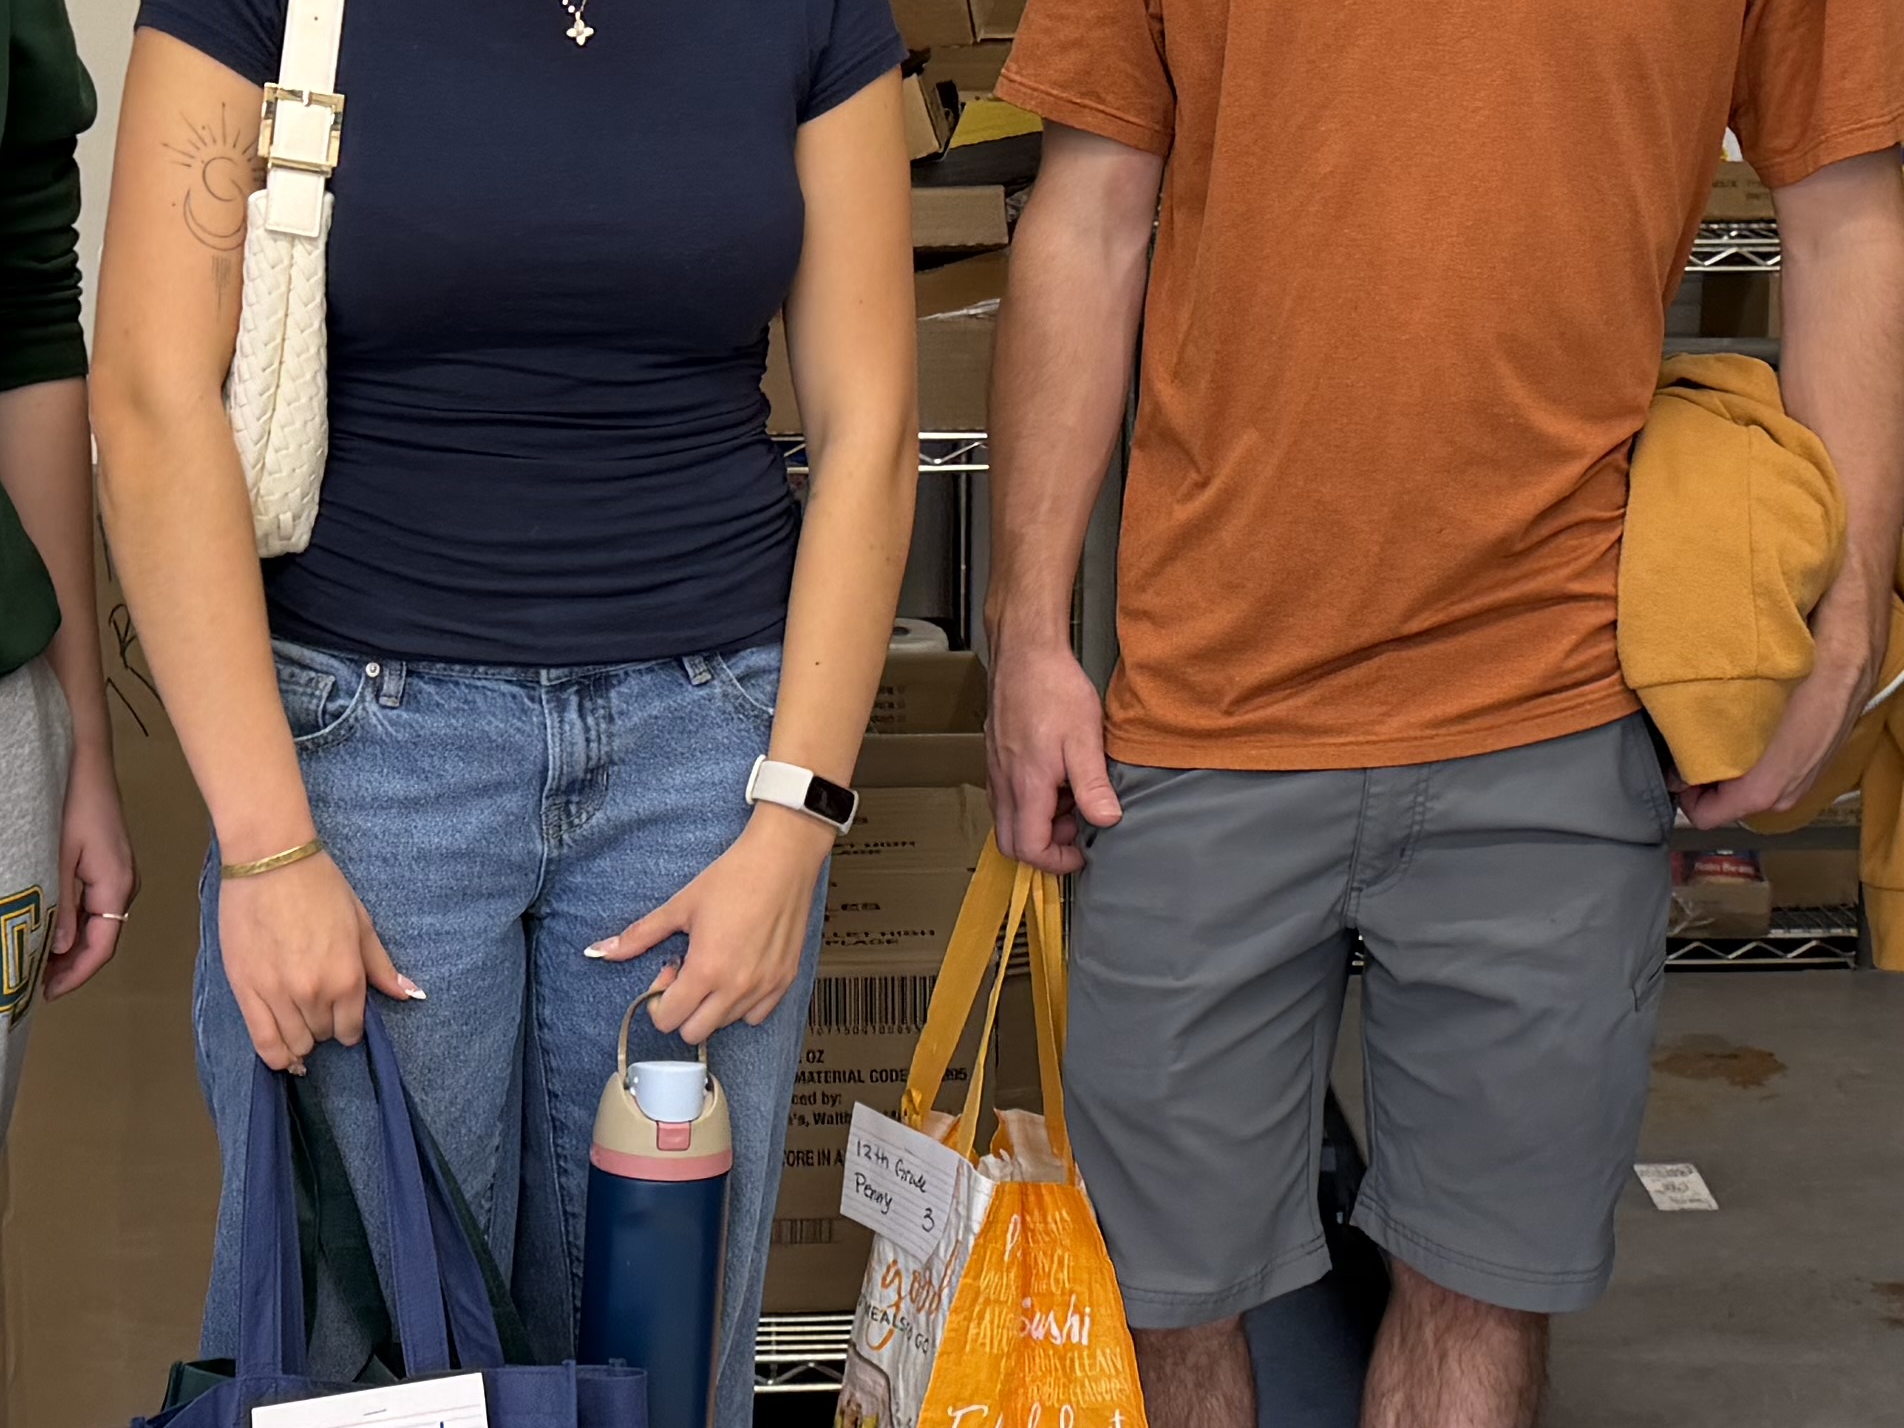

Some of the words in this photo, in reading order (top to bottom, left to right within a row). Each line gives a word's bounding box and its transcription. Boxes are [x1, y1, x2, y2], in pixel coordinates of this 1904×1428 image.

[805, 1049, 825, 1064] OZ
[795, 1068, 866, 1085] MATERIAL
[821, 1093, 842, 1109] by:
[816, 1148, 831, 1167] IN
[855, 1139, 890, 1169] 12th
[854, 1171, 893, 1216] Penny
[921, 1207, 936, 1233] 3
